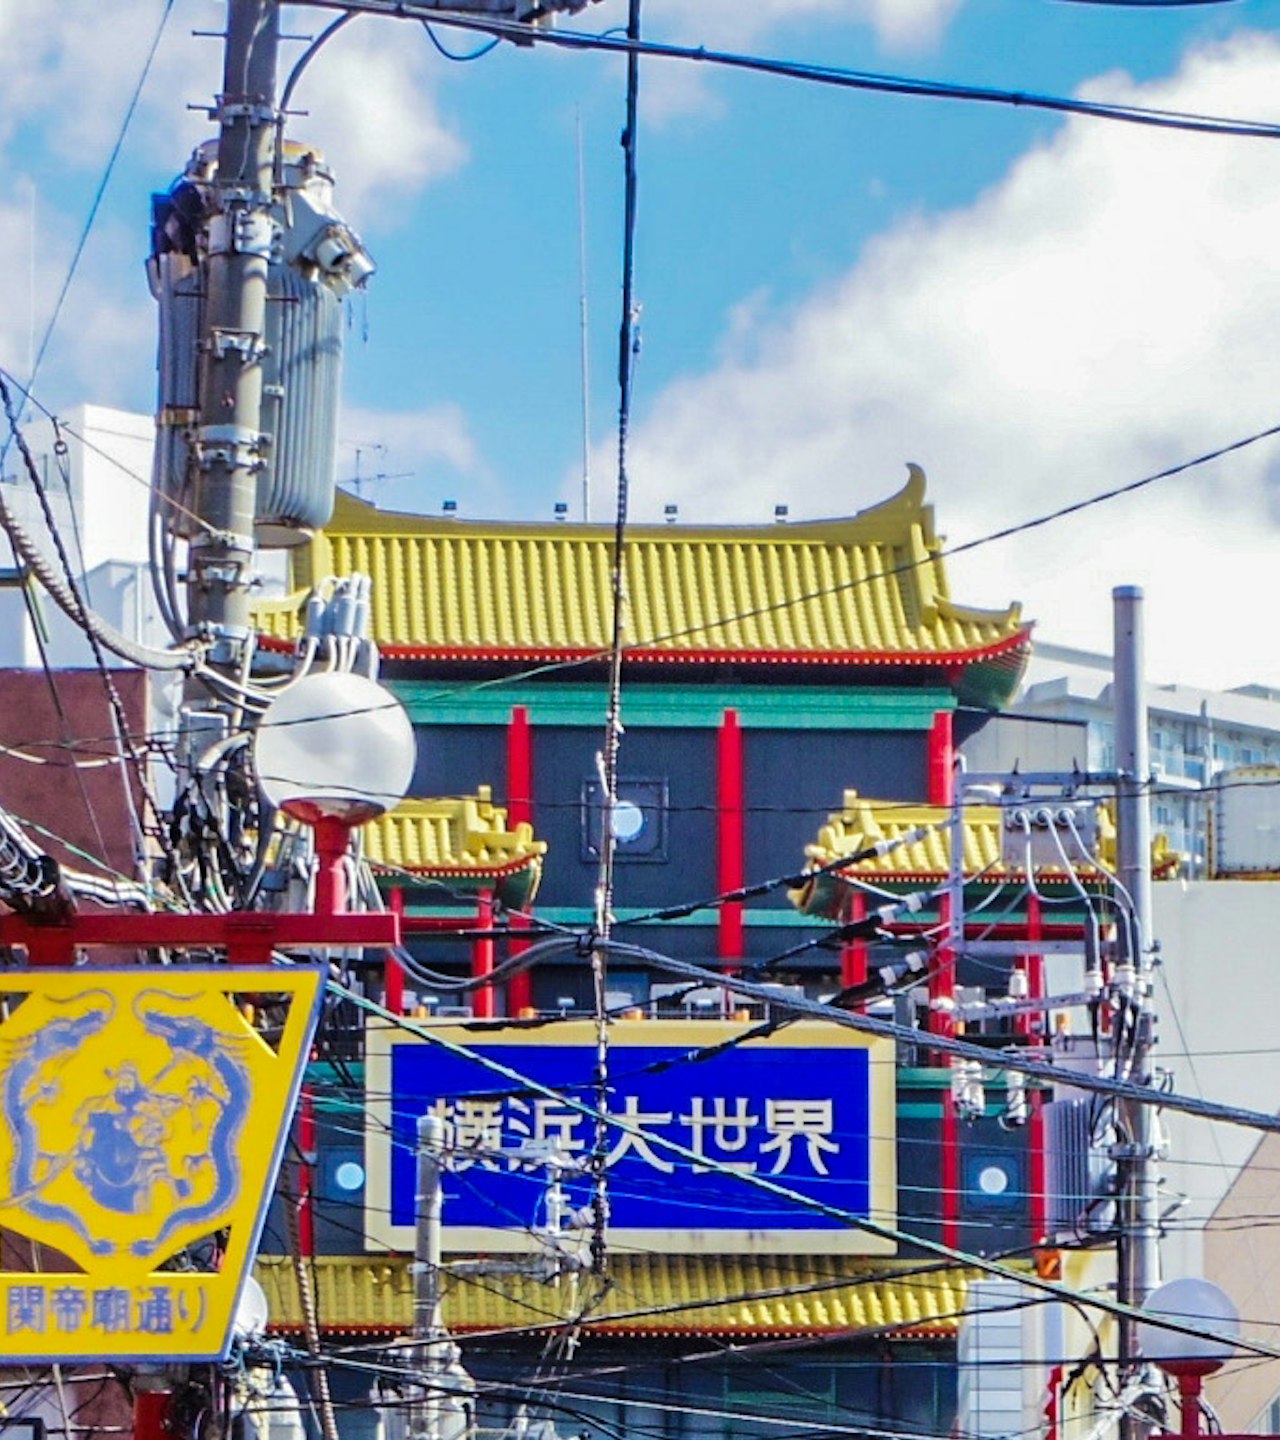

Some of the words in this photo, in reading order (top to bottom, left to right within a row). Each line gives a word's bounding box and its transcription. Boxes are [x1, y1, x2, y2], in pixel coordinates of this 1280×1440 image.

[425, 1095, 840, 1176] 横浜大世界
[6, 1284, 208, 1335] 関帝廟通り
